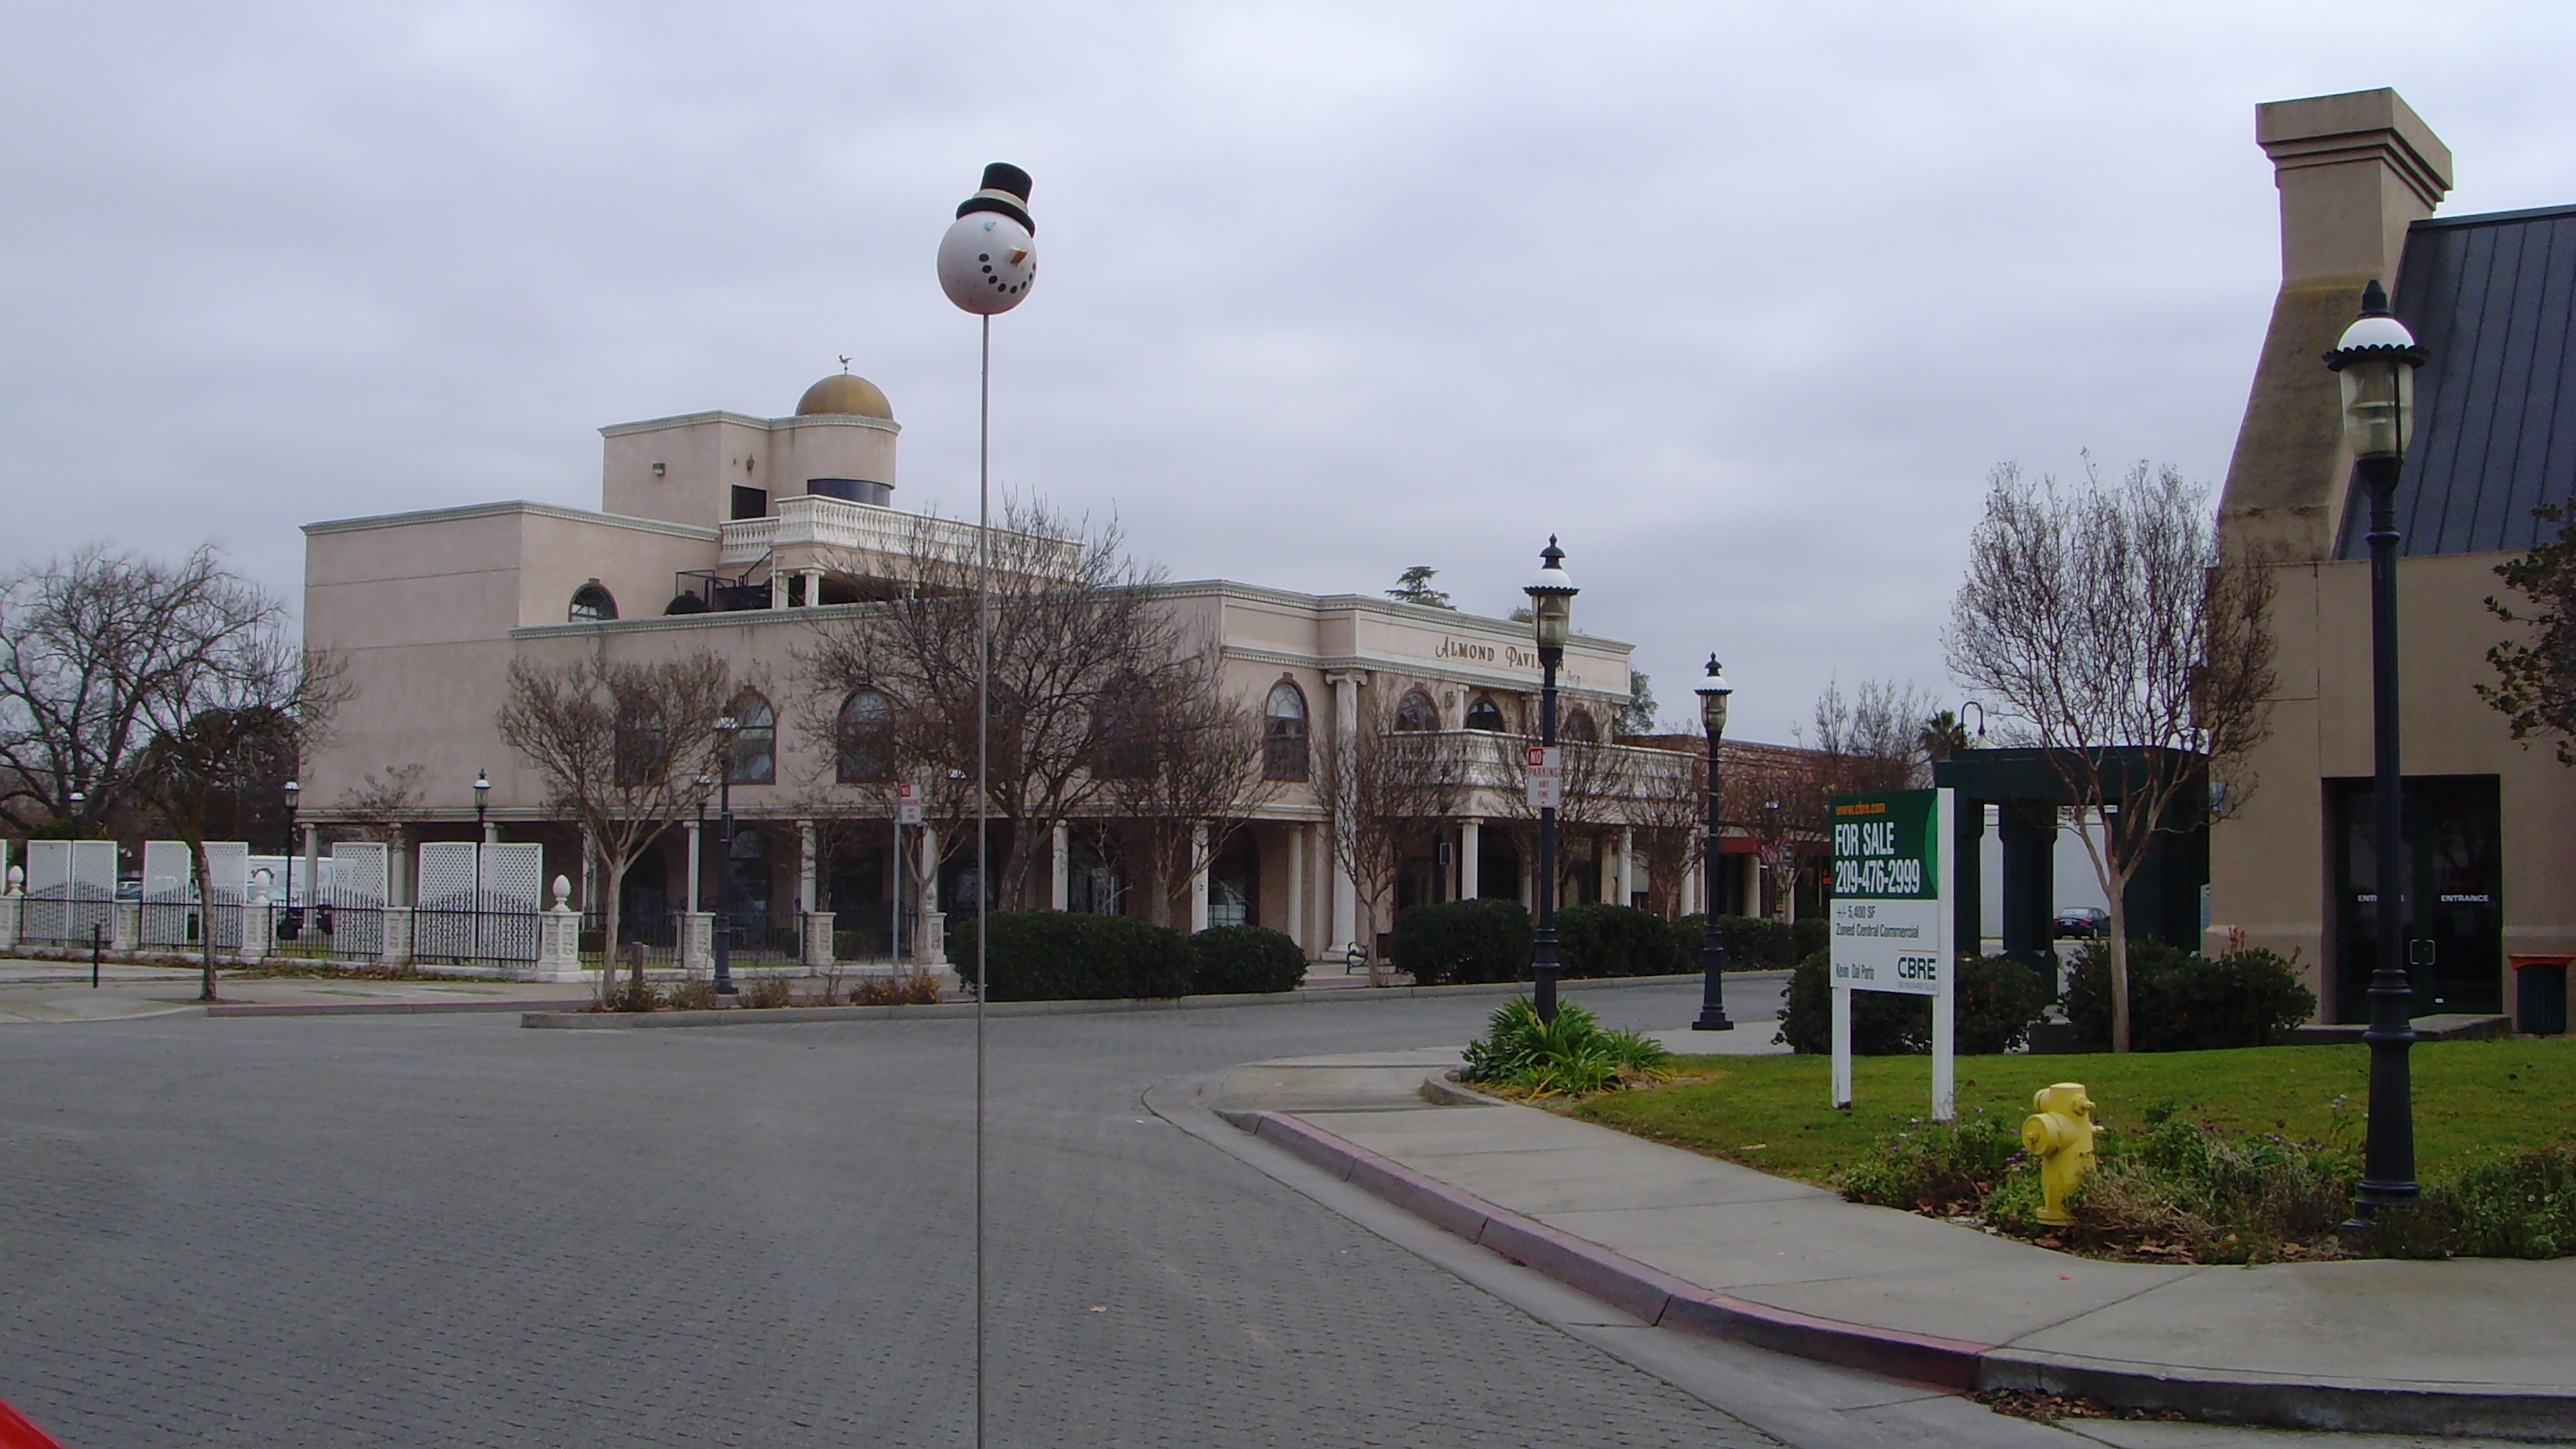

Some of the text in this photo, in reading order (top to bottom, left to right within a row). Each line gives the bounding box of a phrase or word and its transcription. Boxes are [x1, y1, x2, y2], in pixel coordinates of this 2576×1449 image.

[1436, 636, 1495, 662] ALMOND
[1530, 750, 1542, 764] NO
[1528, 766, 1561, 777] PARKING
[1835, 822, 1894, 856] FOR SALE
[1835, 859, 1920, 894] 209-476-2999
[2440, 894, 2490, 902] ENTRANCE
[1867, 906, 1876, 919] SF
[1836, 922, 1919, 938] Zoned Central Commercial
[1836, 963, 1849, 978] Kevin
[1898, 957, 1936, 980] CBRE
